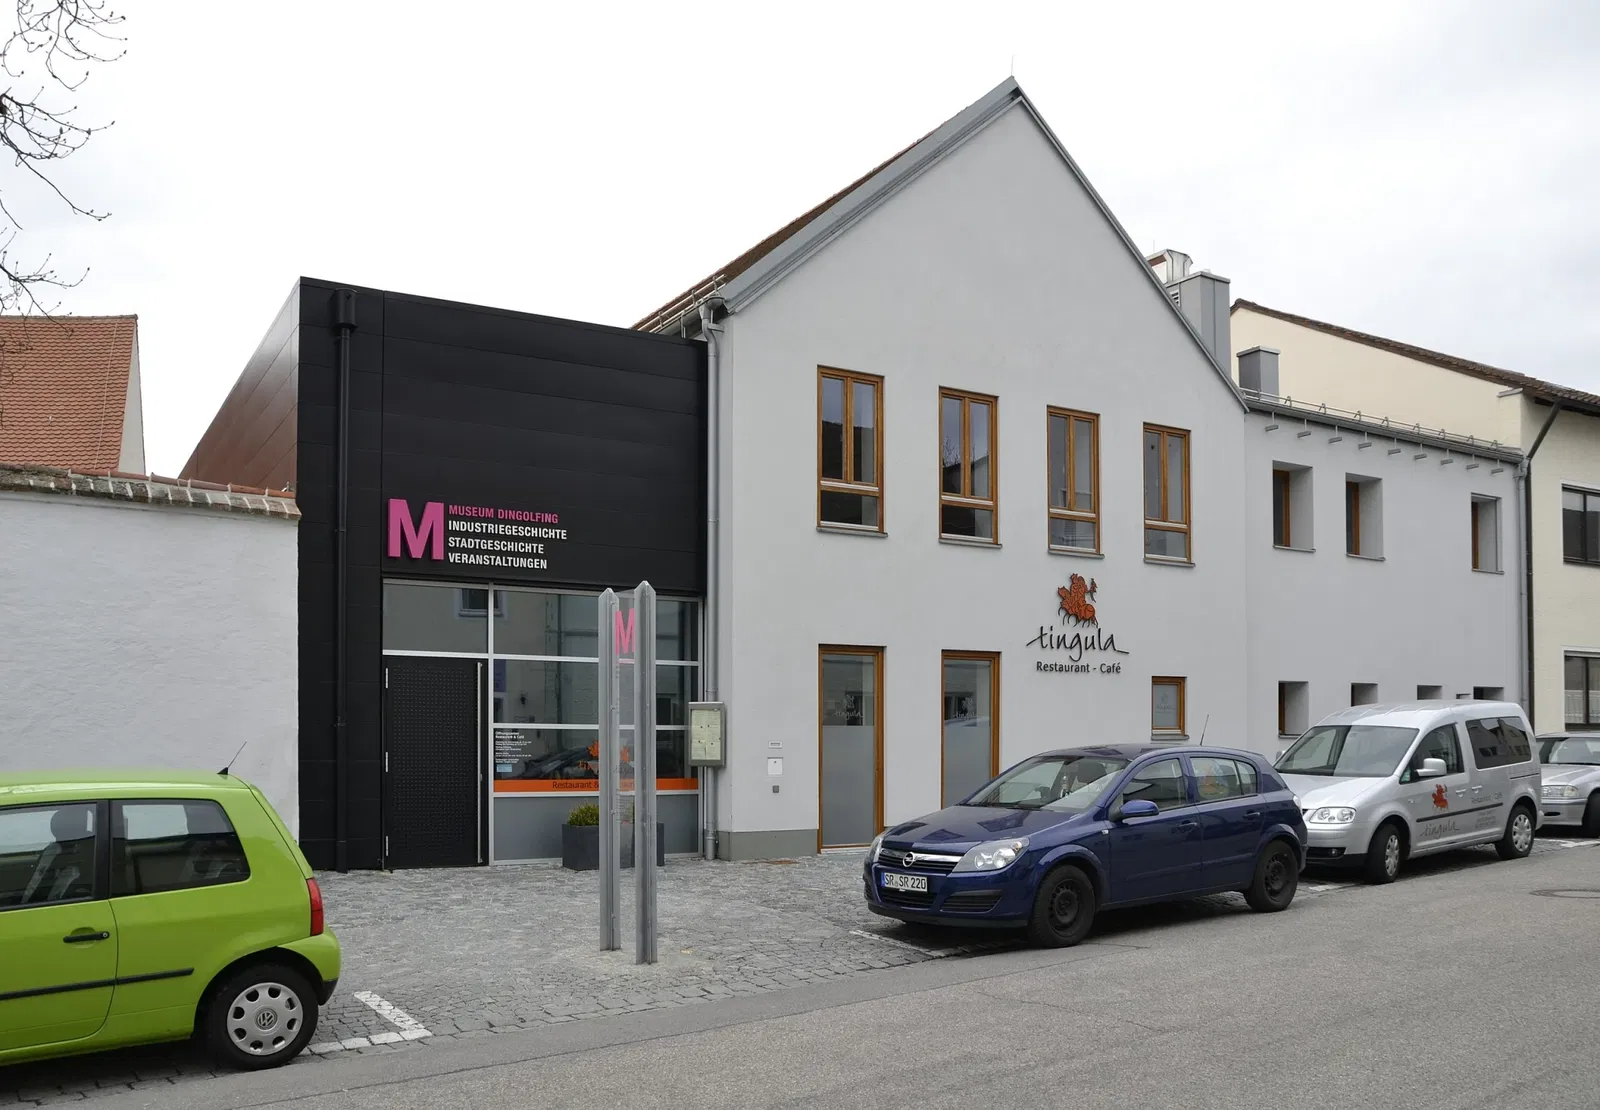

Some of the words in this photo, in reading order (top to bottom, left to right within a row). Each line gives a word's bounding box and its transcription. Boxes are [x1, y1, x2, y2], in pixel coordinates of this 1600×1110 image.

[448, 505, 494, 518] MUSEUM
[498, 509, 559, 524] DINGOLFING
[387, 498, 445, 560] M
[448, 520, 567, 540] INDUSTRIEGESCHICHTE
[448, 537, 544, 554] STADTGESCHICHTE
[448, 552, 548, 569] VERANSTALTUNGEN
[615, 607, 636, 655] M
[1026, 625, 1130, 662] tingula
[1036, 661, 1090, 673] Restaurant
[1100, 662, 1121, 673] Café
[552, 781, 592, 789] Restaurant
[885, 874, 894, 886] SR
[899, 876, 909, 888] SR
[911, 877, 926, 889] 220
